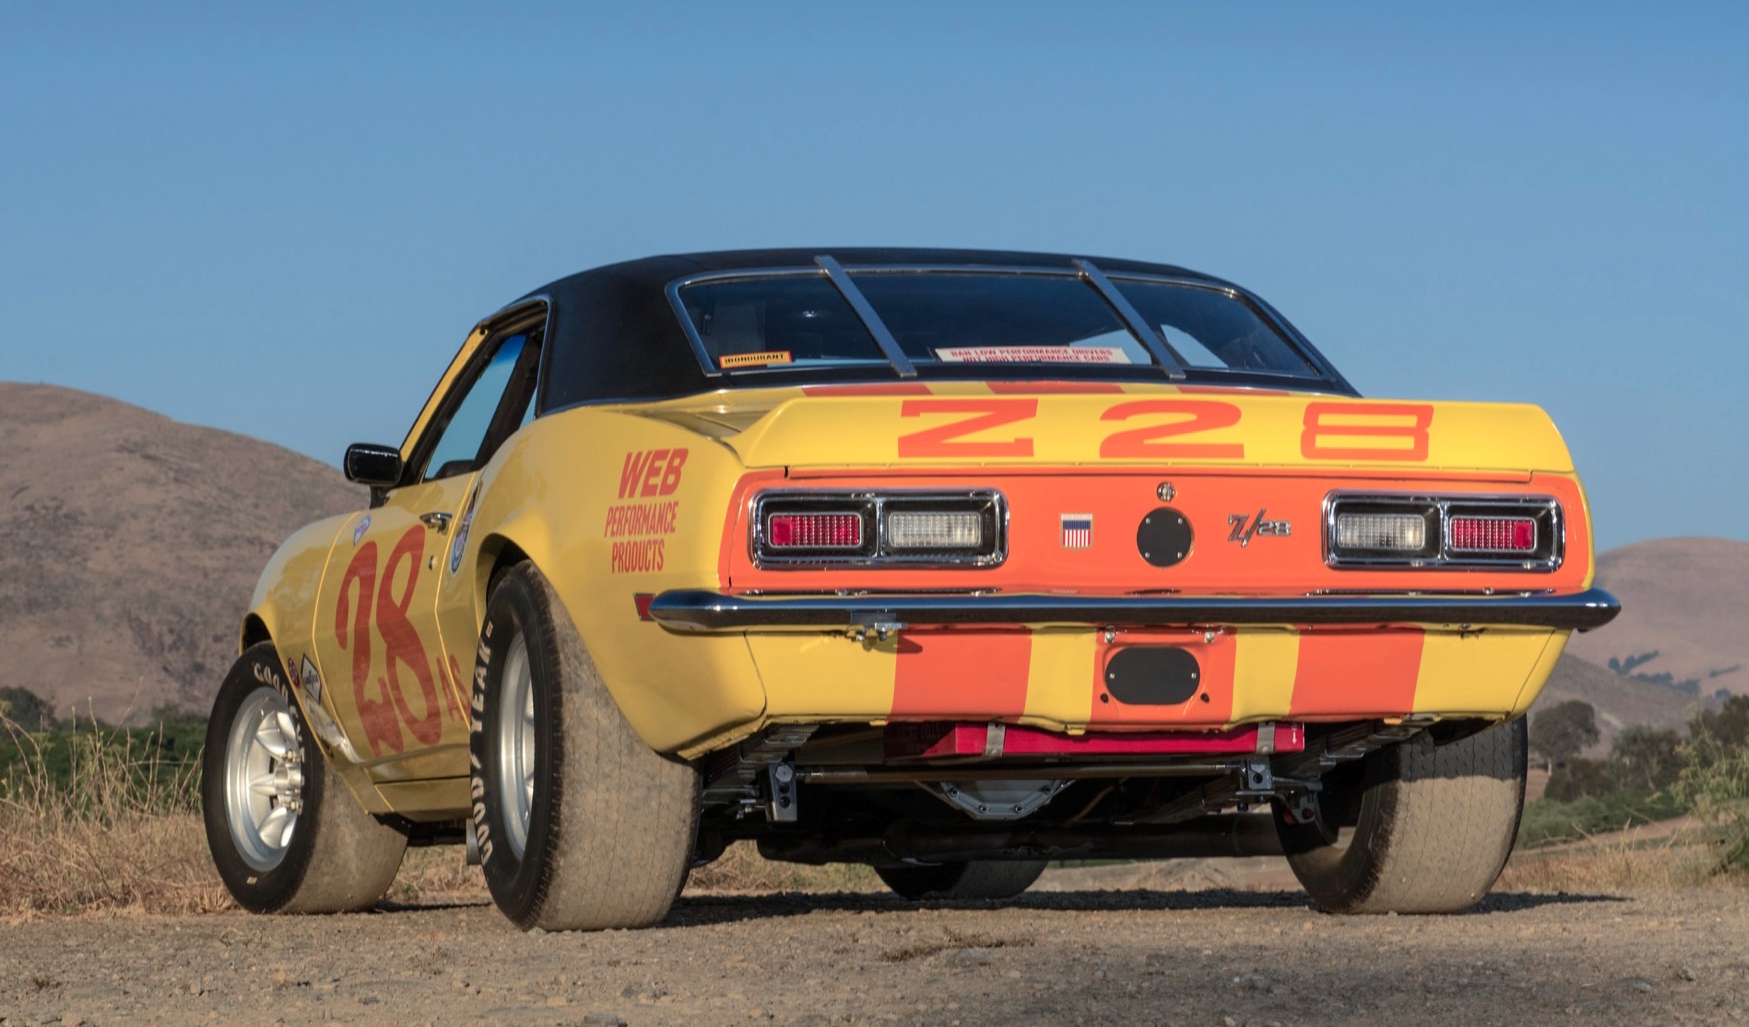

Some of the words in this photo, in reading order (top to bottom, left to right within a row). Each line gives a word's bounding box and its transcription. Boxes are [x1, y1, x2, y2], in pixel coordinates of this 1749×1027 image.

[618, 447, 689, 500] WEB
[604, 501, 679, 538] PERFORMANCE
[612, 538, 665, 574] PRODUCTS
[335, 523, 443, 758] 28
